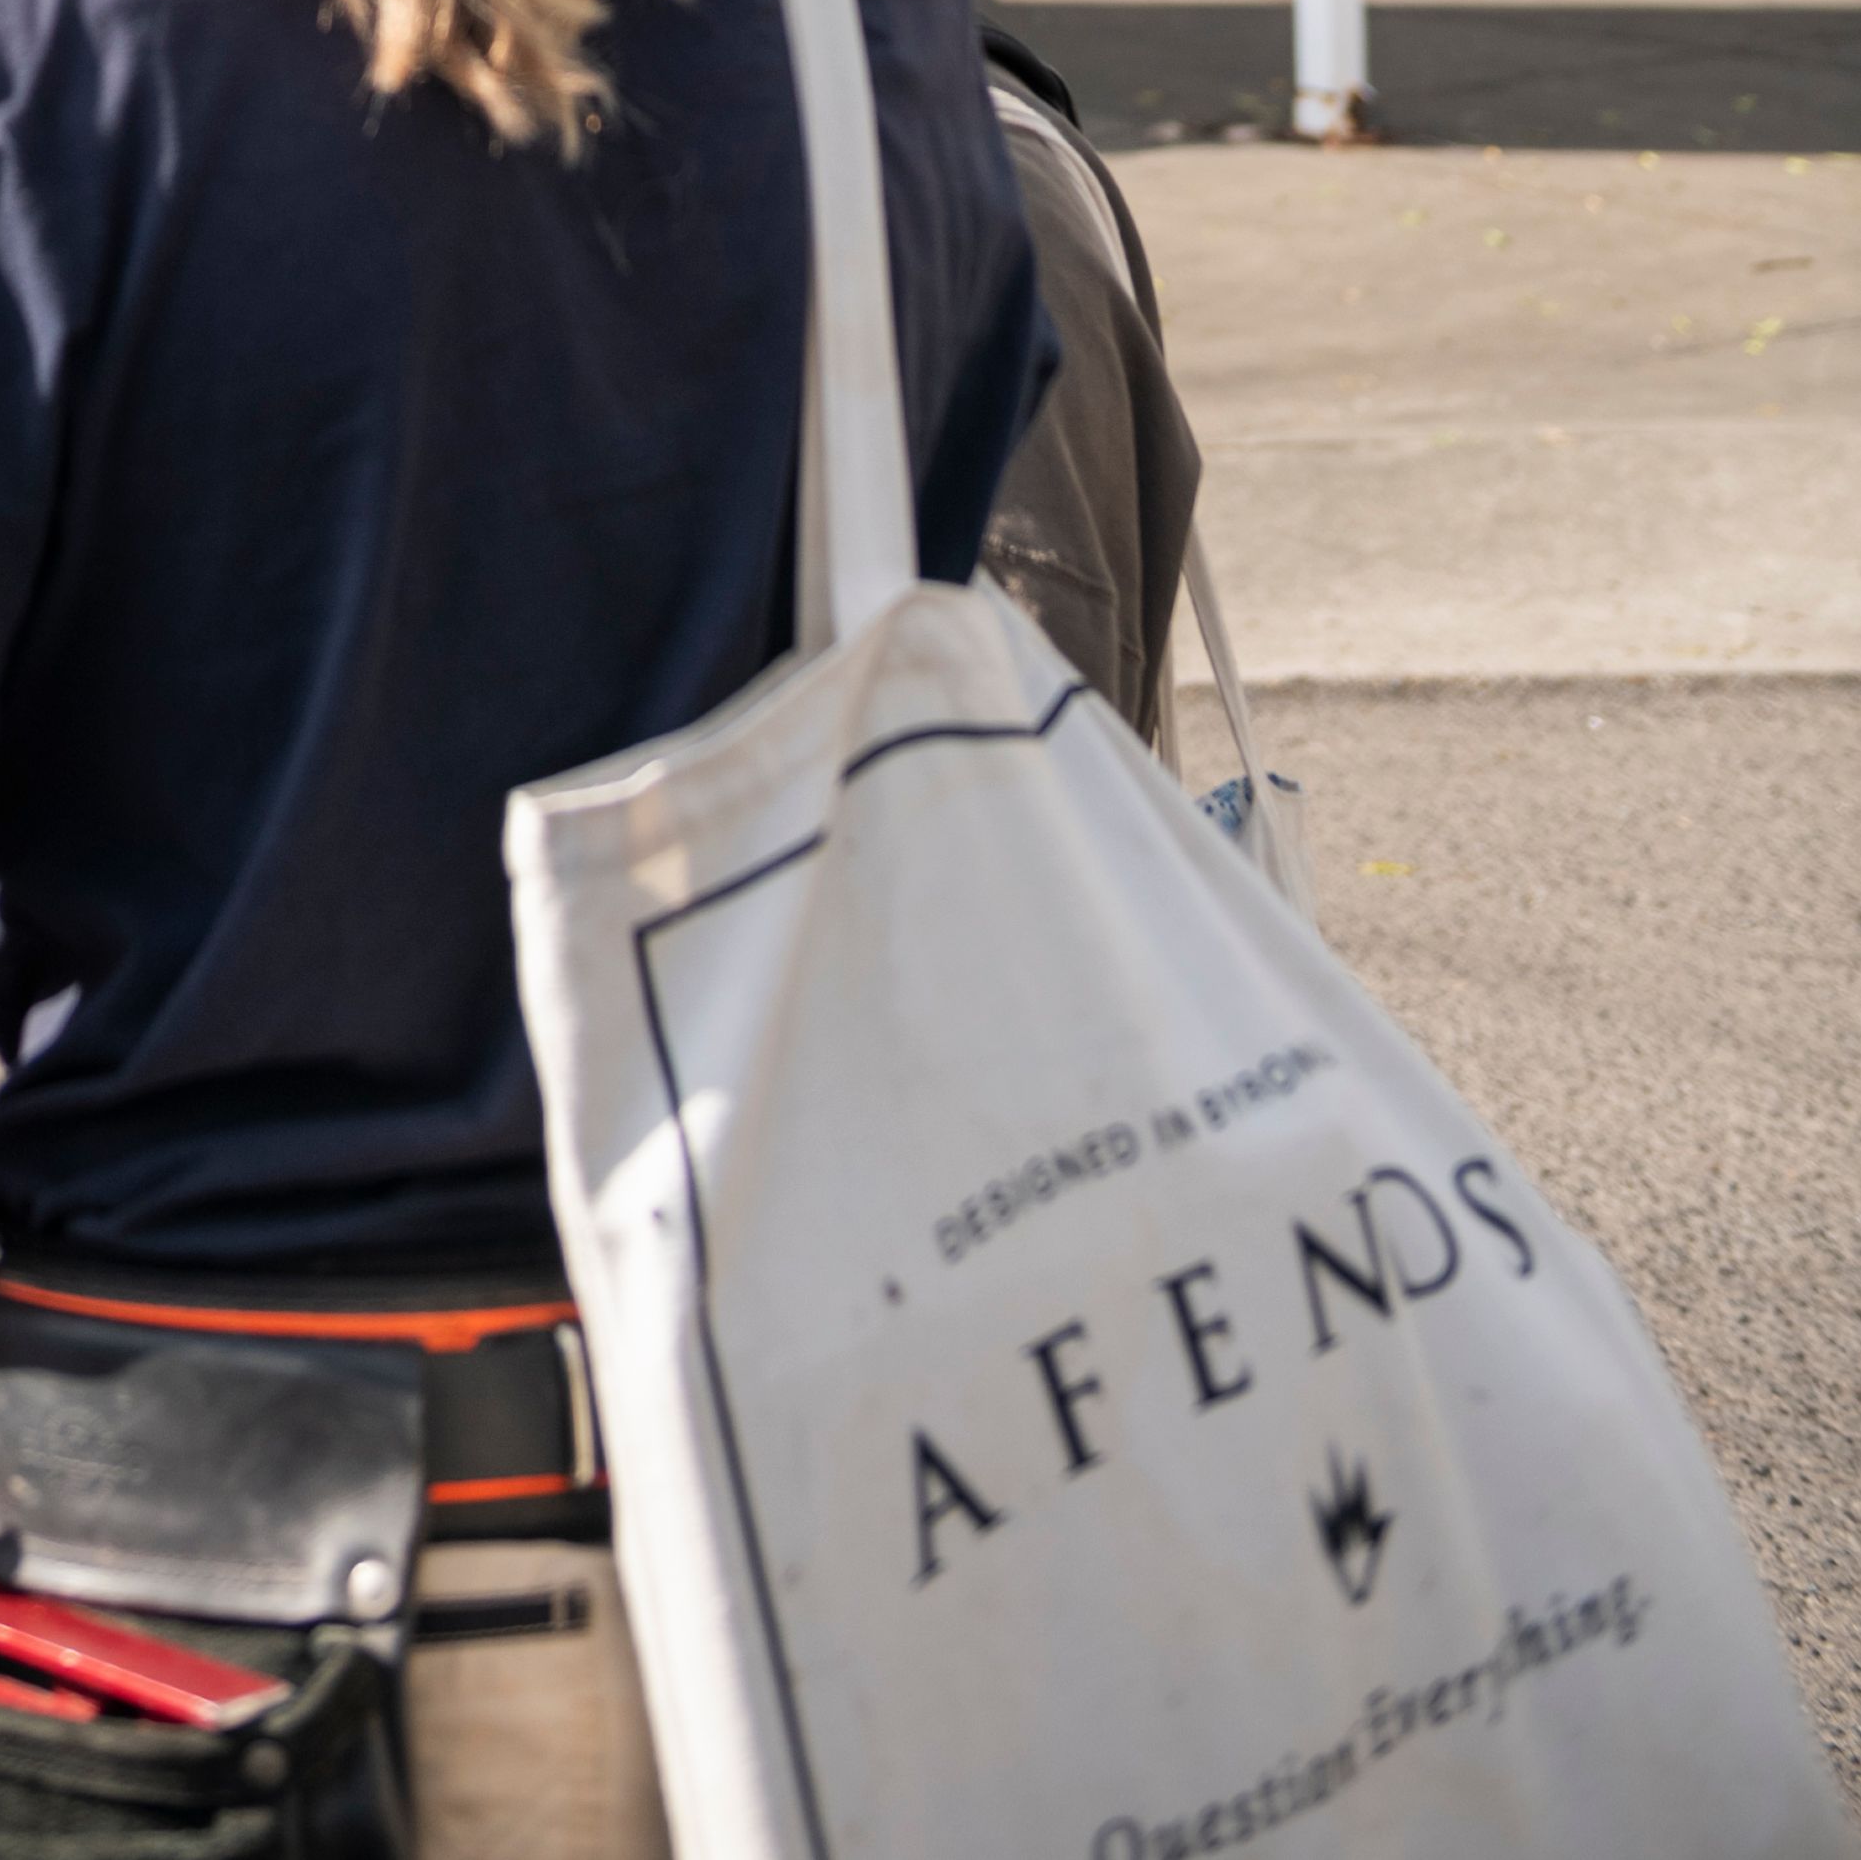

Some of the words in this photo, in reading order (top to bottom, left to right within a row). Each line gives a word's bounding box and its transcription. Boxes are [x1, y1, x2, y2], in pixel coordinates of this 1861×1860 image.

[934, 1120, 1141, 1264] DESIGNED
[1150, 1106, 1195, 1152] IN
[908, 1152, 1538, 1589] AFENDS
